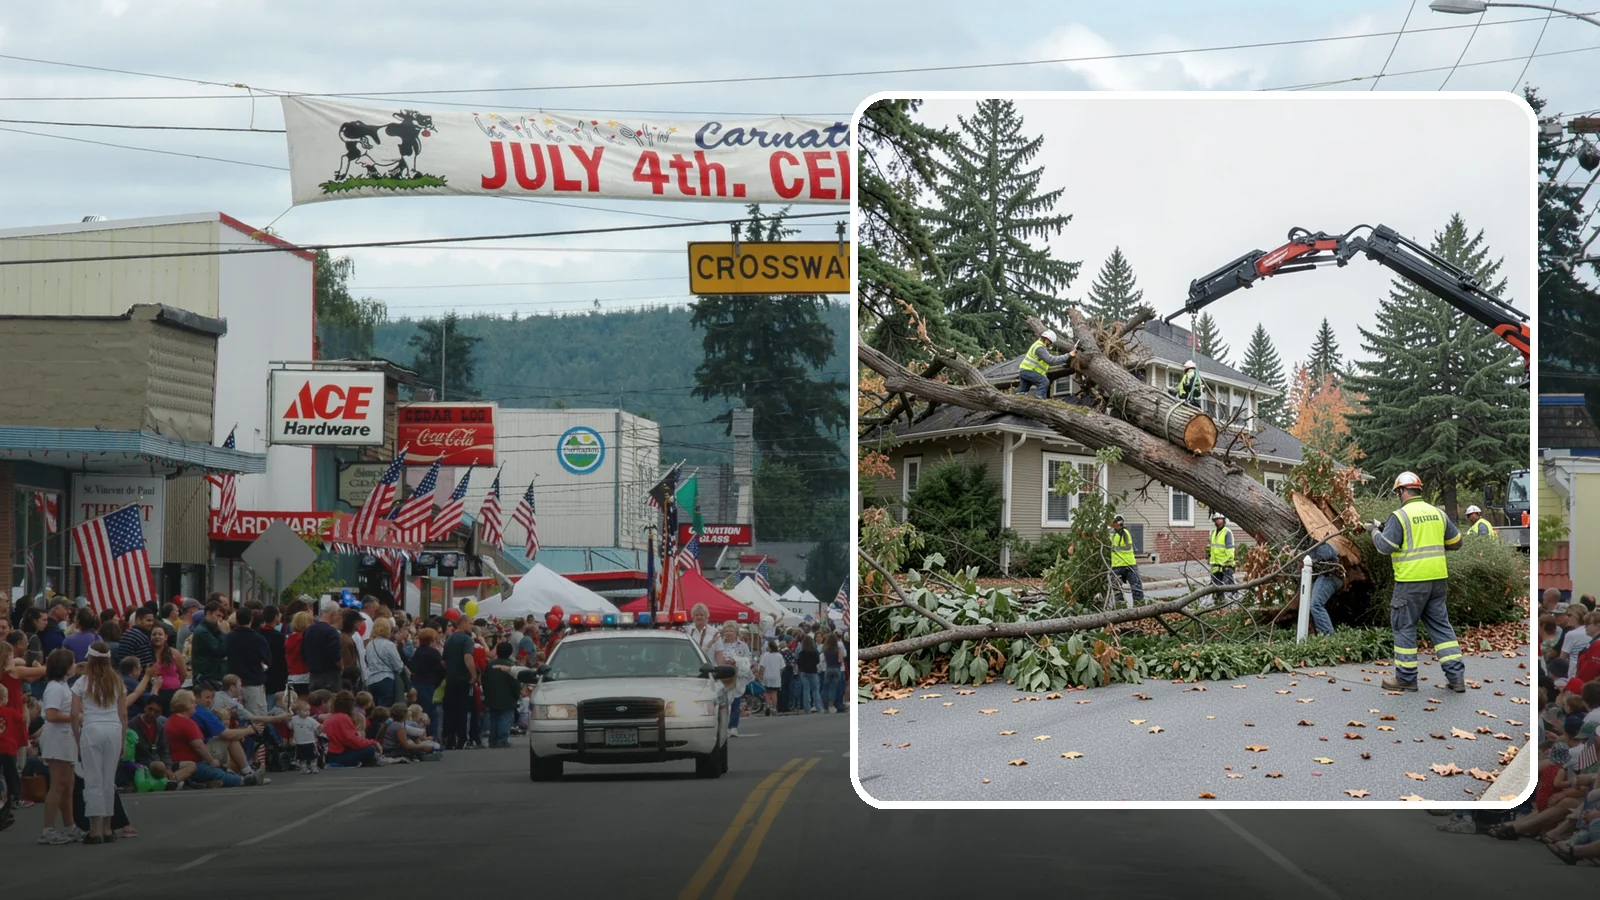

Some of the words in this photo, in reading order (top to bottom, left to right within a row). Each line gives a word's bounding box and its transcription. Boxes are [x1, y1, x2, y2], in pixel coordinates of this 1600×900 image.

[481, 140, 605, 192] JULY
[632, 149, 746, 198] 4th.
[696, 254, 850, 280] CROSSWA
[282, 380, 374, 420] ACE
[405, 409, 452, 422] CEDAR
[461, 409, 485, 422] LOG
[283, 421, 371, 437] Hardware
[416, 428, 476, 447] Coca-Cola
[353, 467, 385, 481] Simpl
[83, 484, 93, 494] St.
[95, 485, 124, 495] Vincent
[126, 486, 135, 495] de
[137, 486, 155, 495] Paul
[688, 526, 741, 535] CRNATION
[699, 535, 730, 543] GLASS
